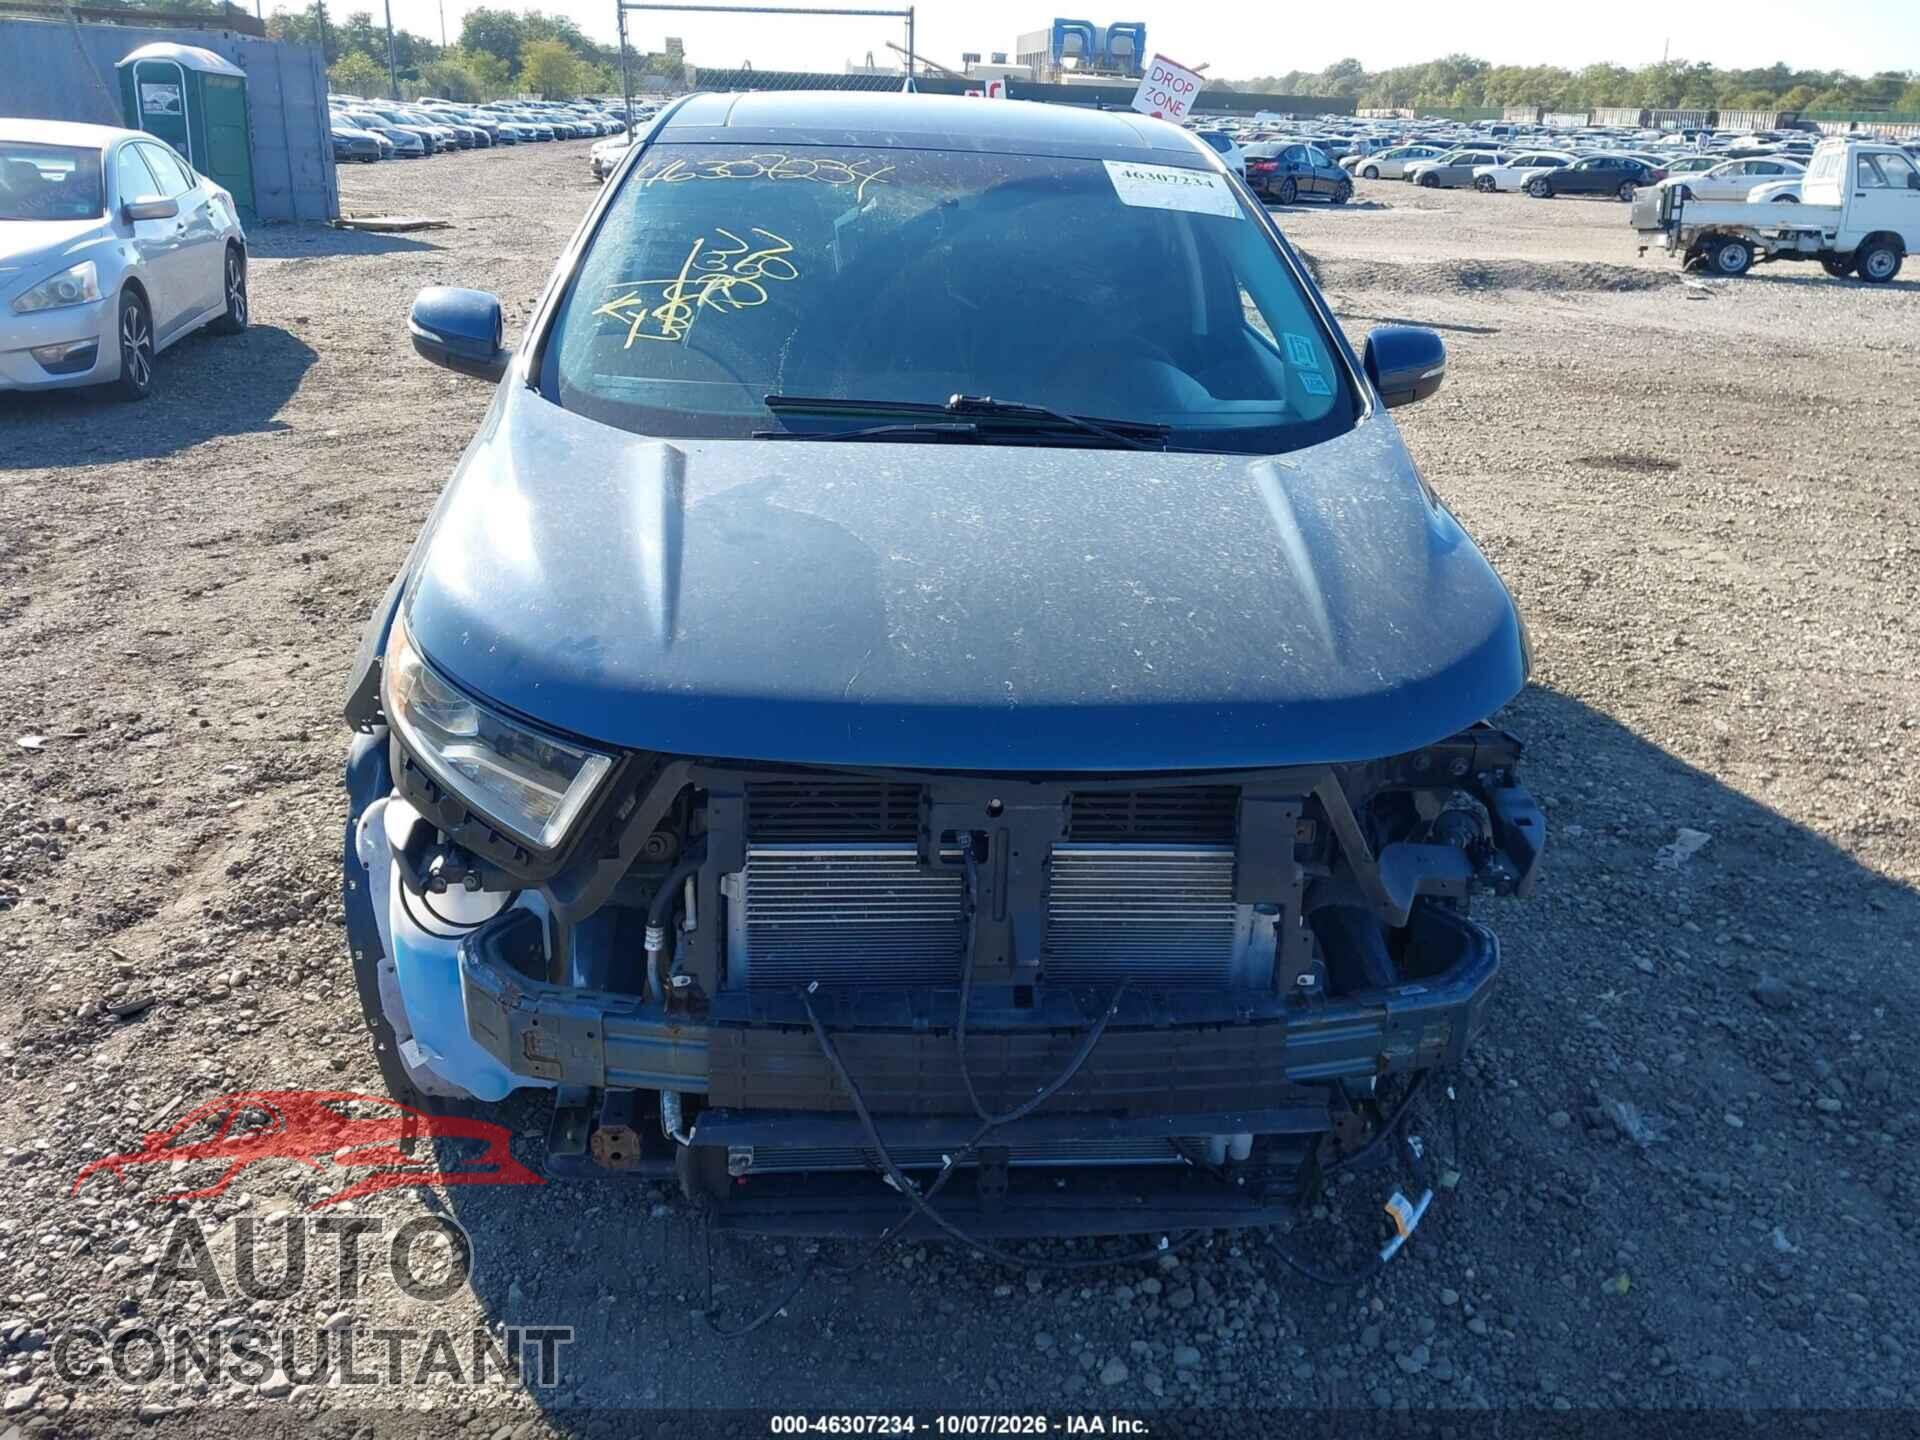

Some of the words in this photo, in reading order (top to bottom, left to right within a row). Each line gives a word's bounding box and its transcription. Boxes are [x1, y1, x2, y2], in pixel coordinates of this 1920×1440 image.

[1151, 66, 1194, 95] DROP
[1144, 86, 1186, 117] ZONE
[634, 152, 896, 203] 46307234
[1117, 169, 1214, 189] 46307234
